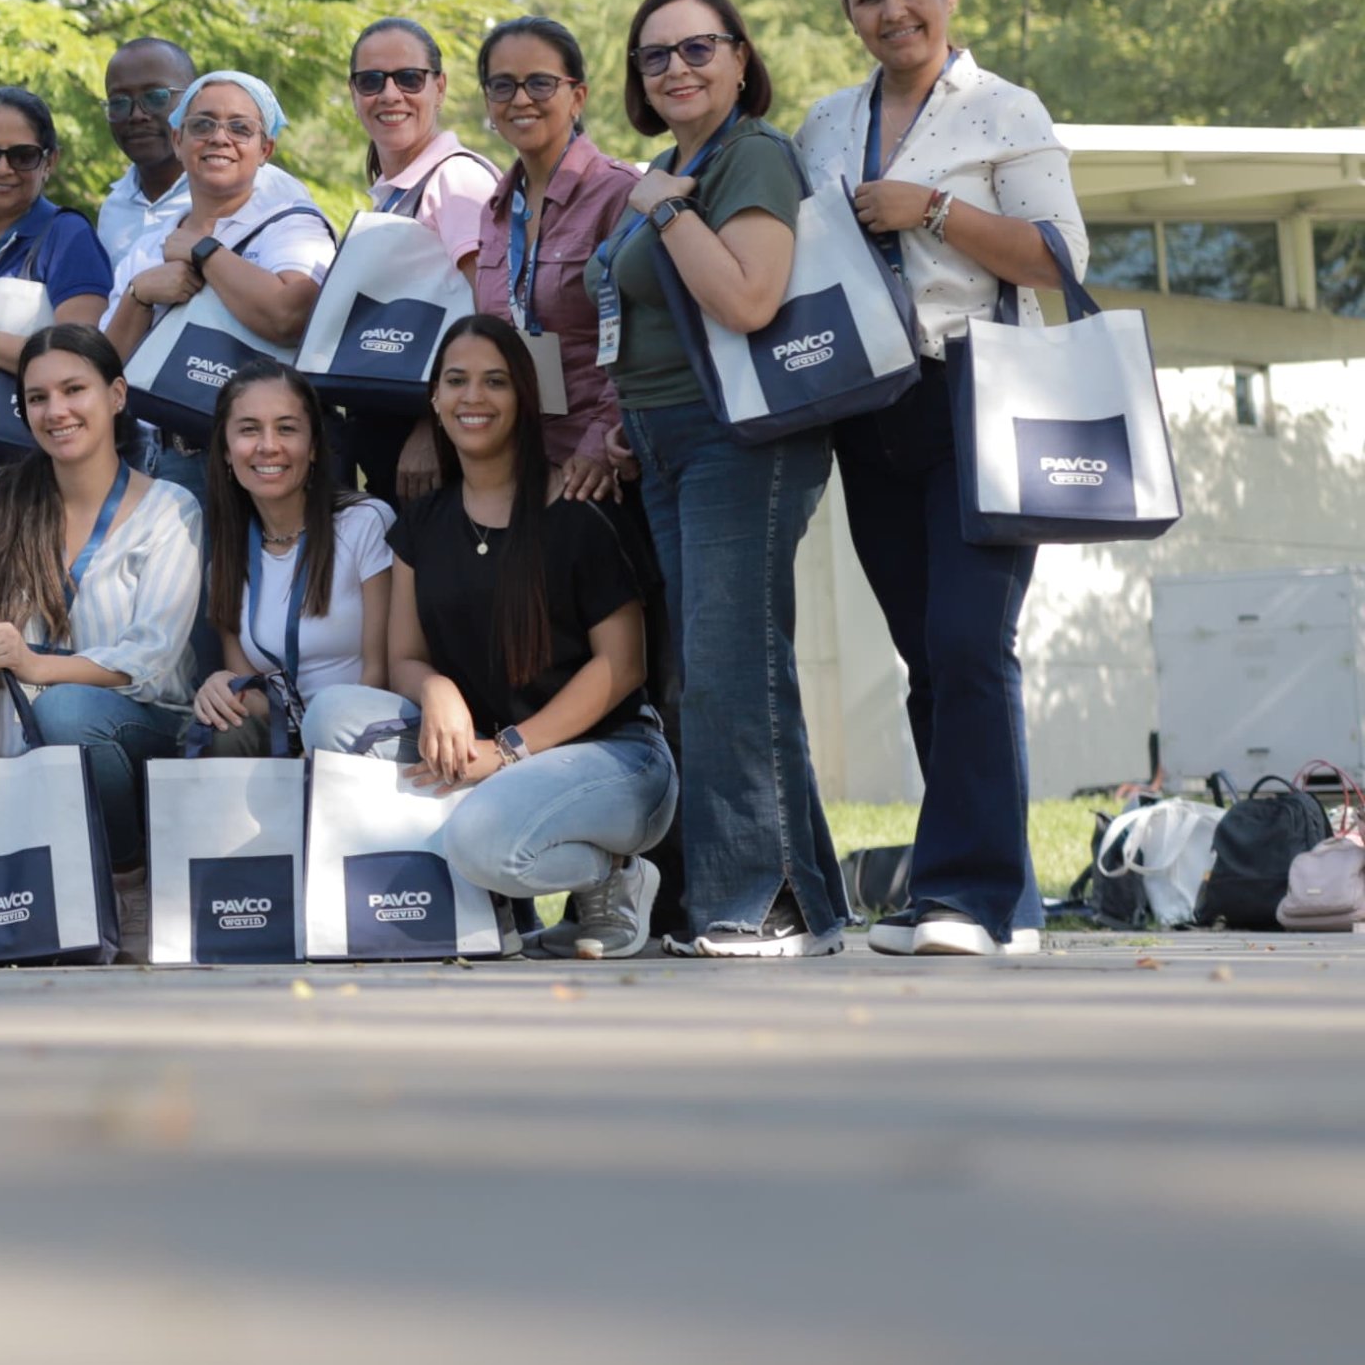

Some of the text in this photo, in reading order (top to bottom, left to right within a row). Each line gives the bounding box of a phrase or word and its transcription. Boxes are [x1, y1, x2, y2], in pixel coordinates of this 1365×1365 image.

[360, 328, 414, 342] PAVCO
[772, 329, 835, 360] PAVCO
[786, 349, 831, 369] wavin
[1040, 456, 1108, 472] PAVCO
[212, 897, 273, 914] PAVCO
[369, 891, 432, 908] PAVCO
[222, 916, 265, 927] wavin
[379, 909, 423, 920] wavin
